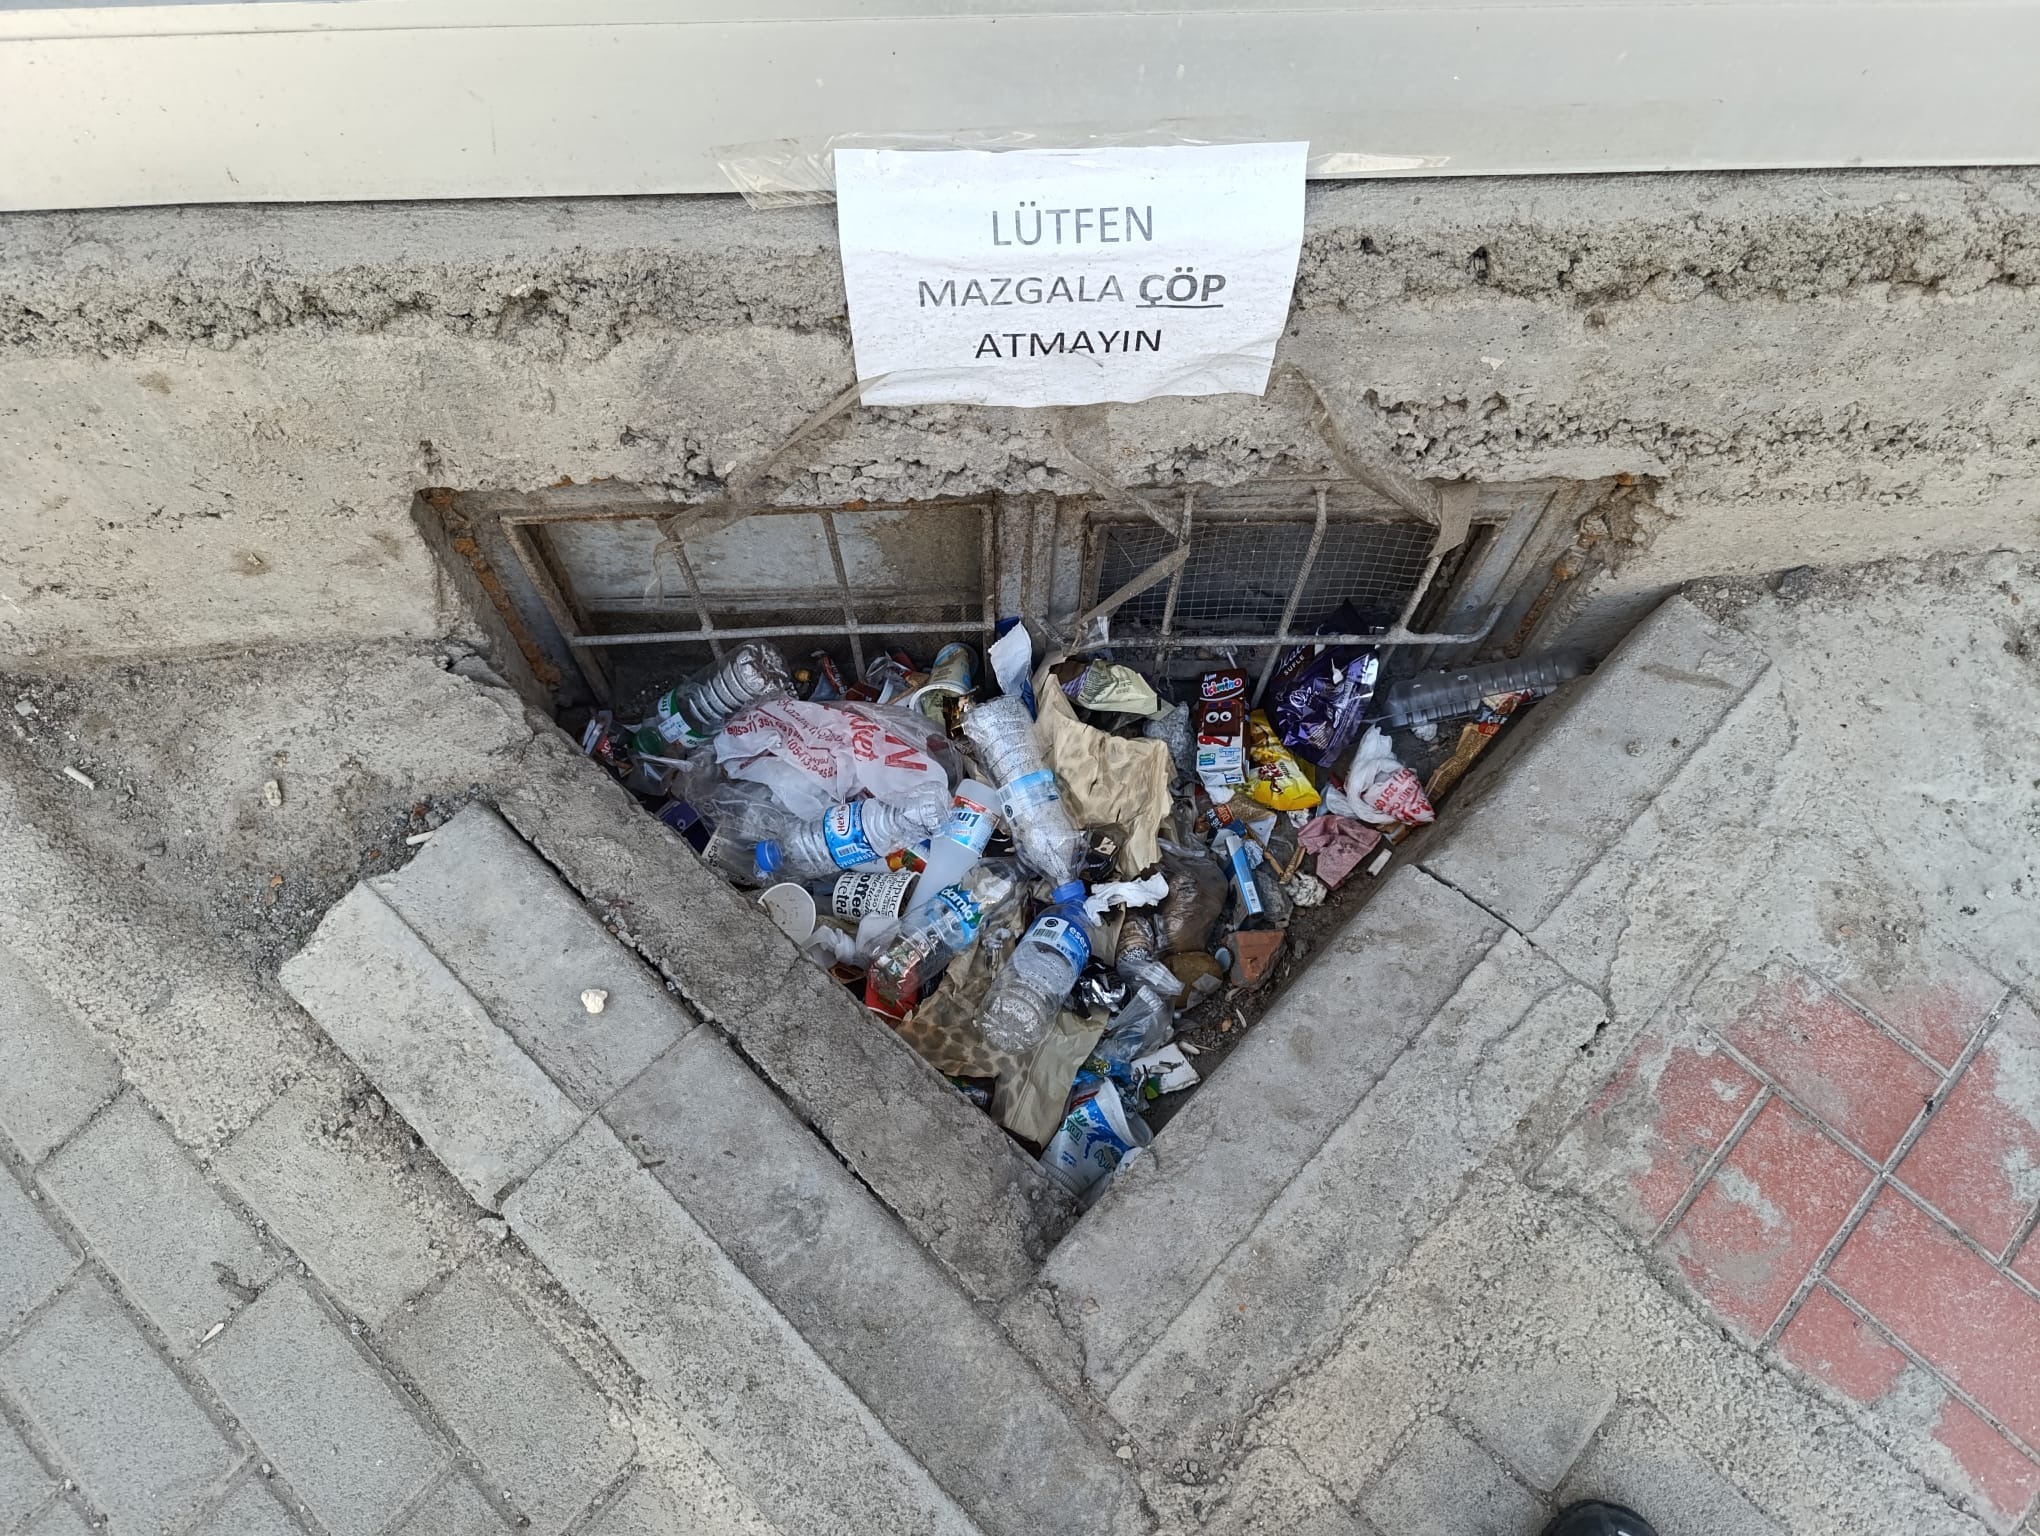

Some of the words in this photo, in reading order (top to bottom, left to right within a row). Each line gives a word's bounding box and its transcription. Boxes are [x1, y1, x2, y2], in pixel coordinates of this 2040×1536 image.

[992, 200, 1153, 246] LÜTFEN
[918, 275, 1124, 308] MAZGALA
[1136, 267, 1226, 308] ÇÖP
[975, 330, 1161, 359] ATMAYIN
[941, 886, 974, 921] damla
